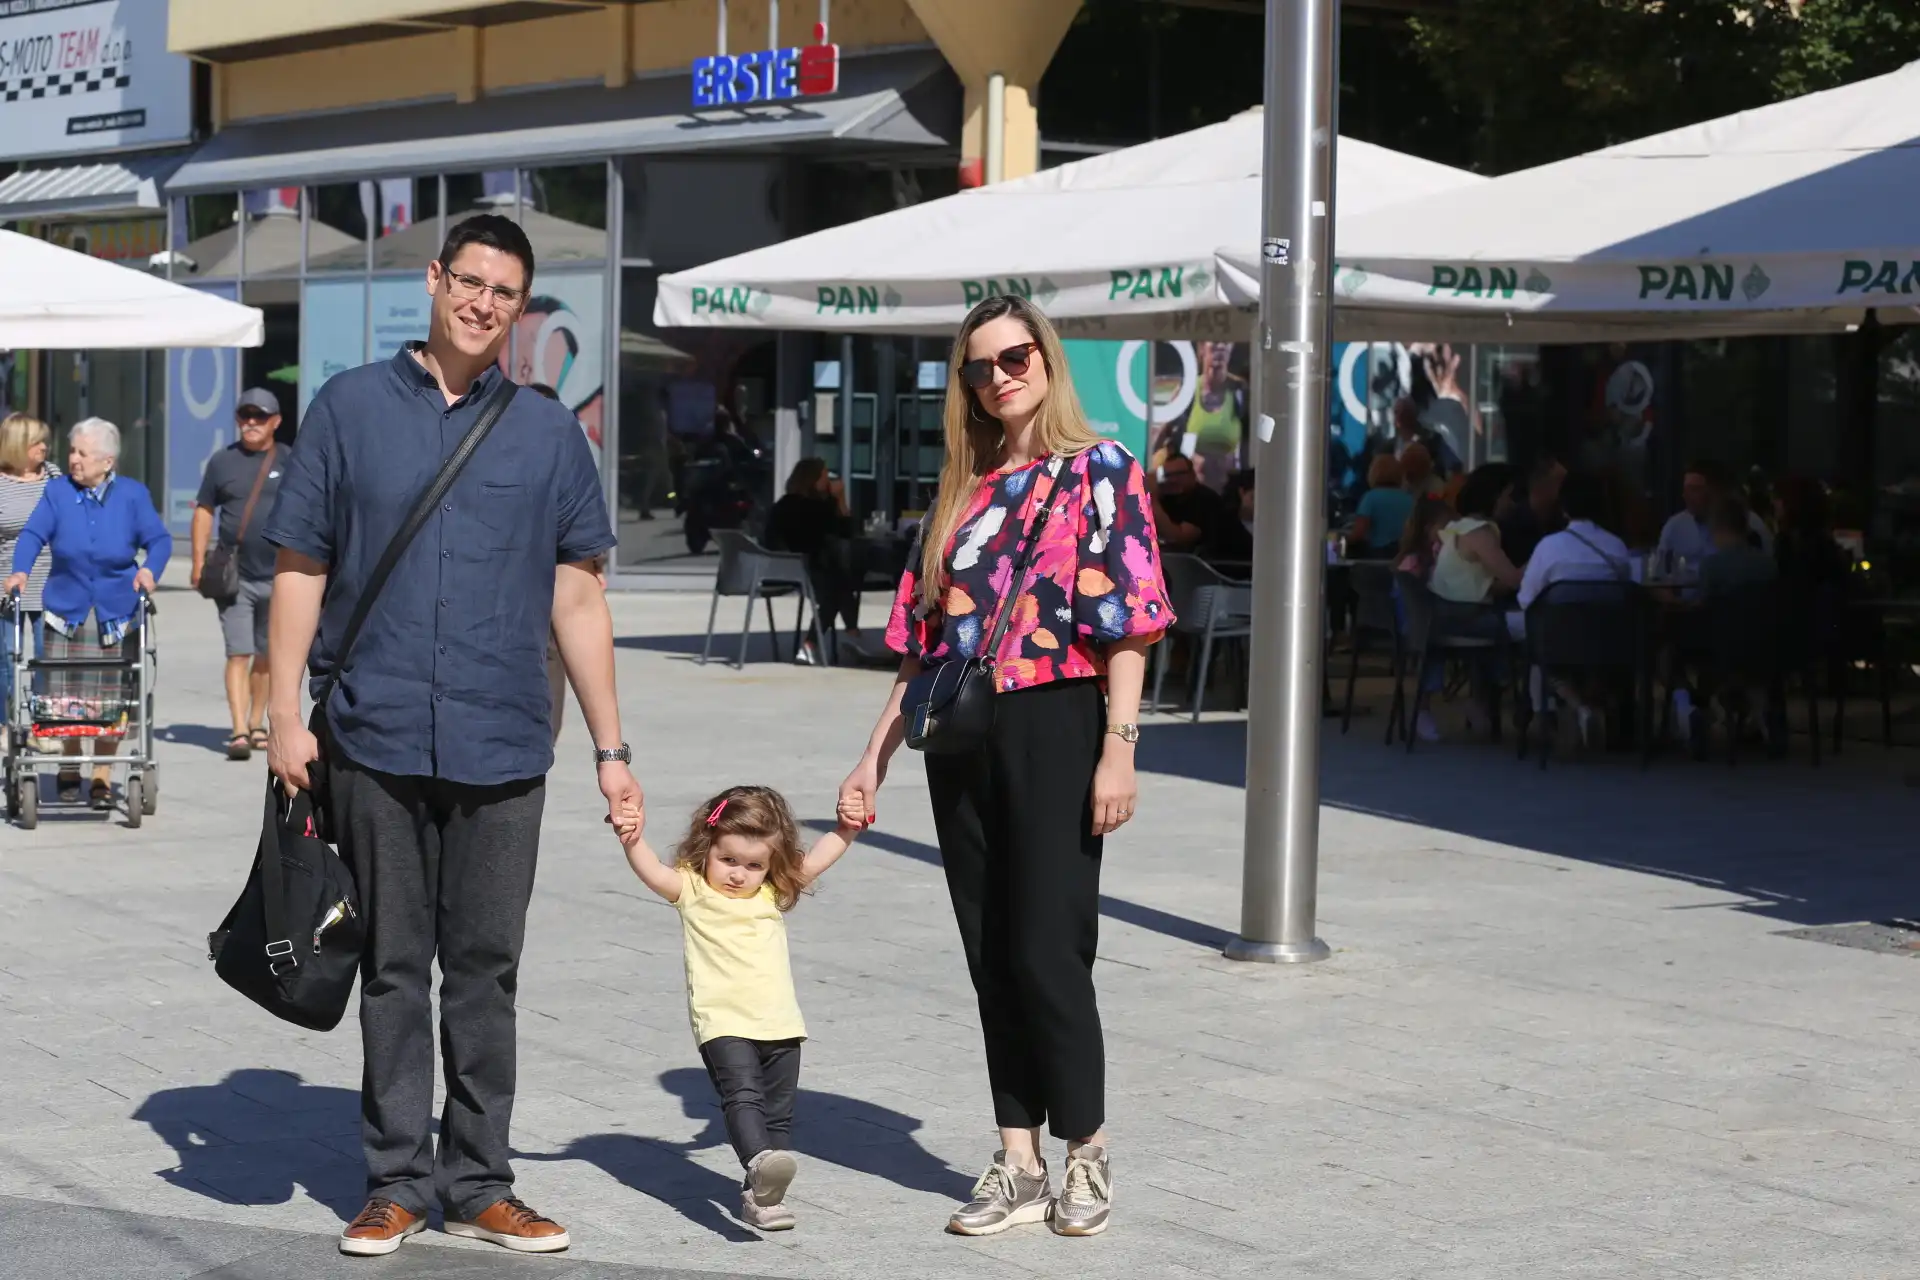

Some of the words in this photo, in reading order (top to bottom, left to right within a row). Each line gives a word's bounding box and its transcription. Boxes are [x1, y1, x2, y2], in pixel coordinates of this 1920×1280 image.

[57, 28, 101, 70] TEAM
[692, 48, 798, 106] ERSTE
[1109, 266, 1184, 300] PAN
[1428, 265, 1518, 299] PAN
[1636, 263, 1735, 301] PAN
[691, 286, 751, 315] PAN
[816, 286, 879, 314] PAN
